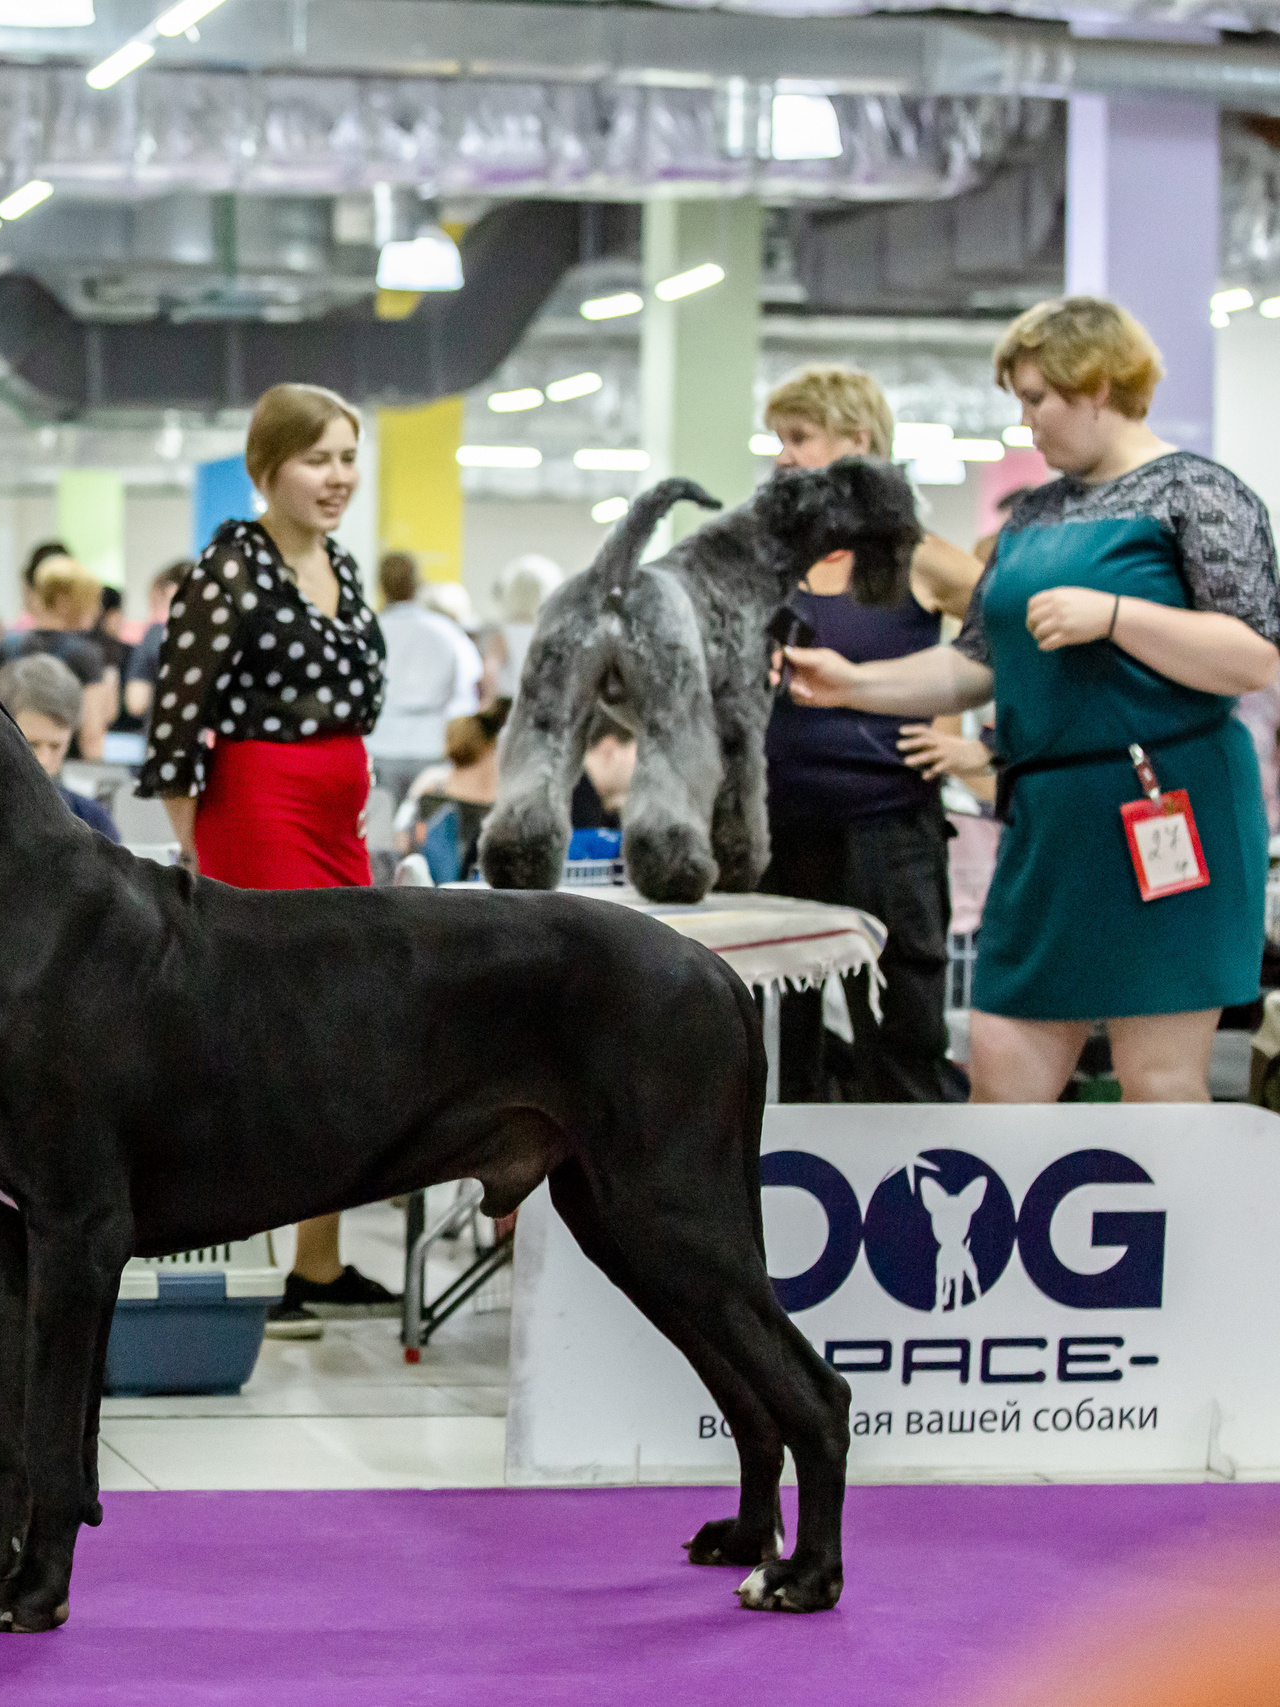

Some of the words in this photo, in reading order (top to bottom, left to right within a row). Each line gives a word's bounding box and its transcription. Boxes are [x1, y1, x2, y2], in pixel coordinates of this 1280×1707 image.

[760, 1148, 1167, 1312] DOG
[812, 1335, 1159, 1387] PACE-
[906, 1400, 1022, 1435] вашей
[1033, 1397, 1158, 1432] собаки
